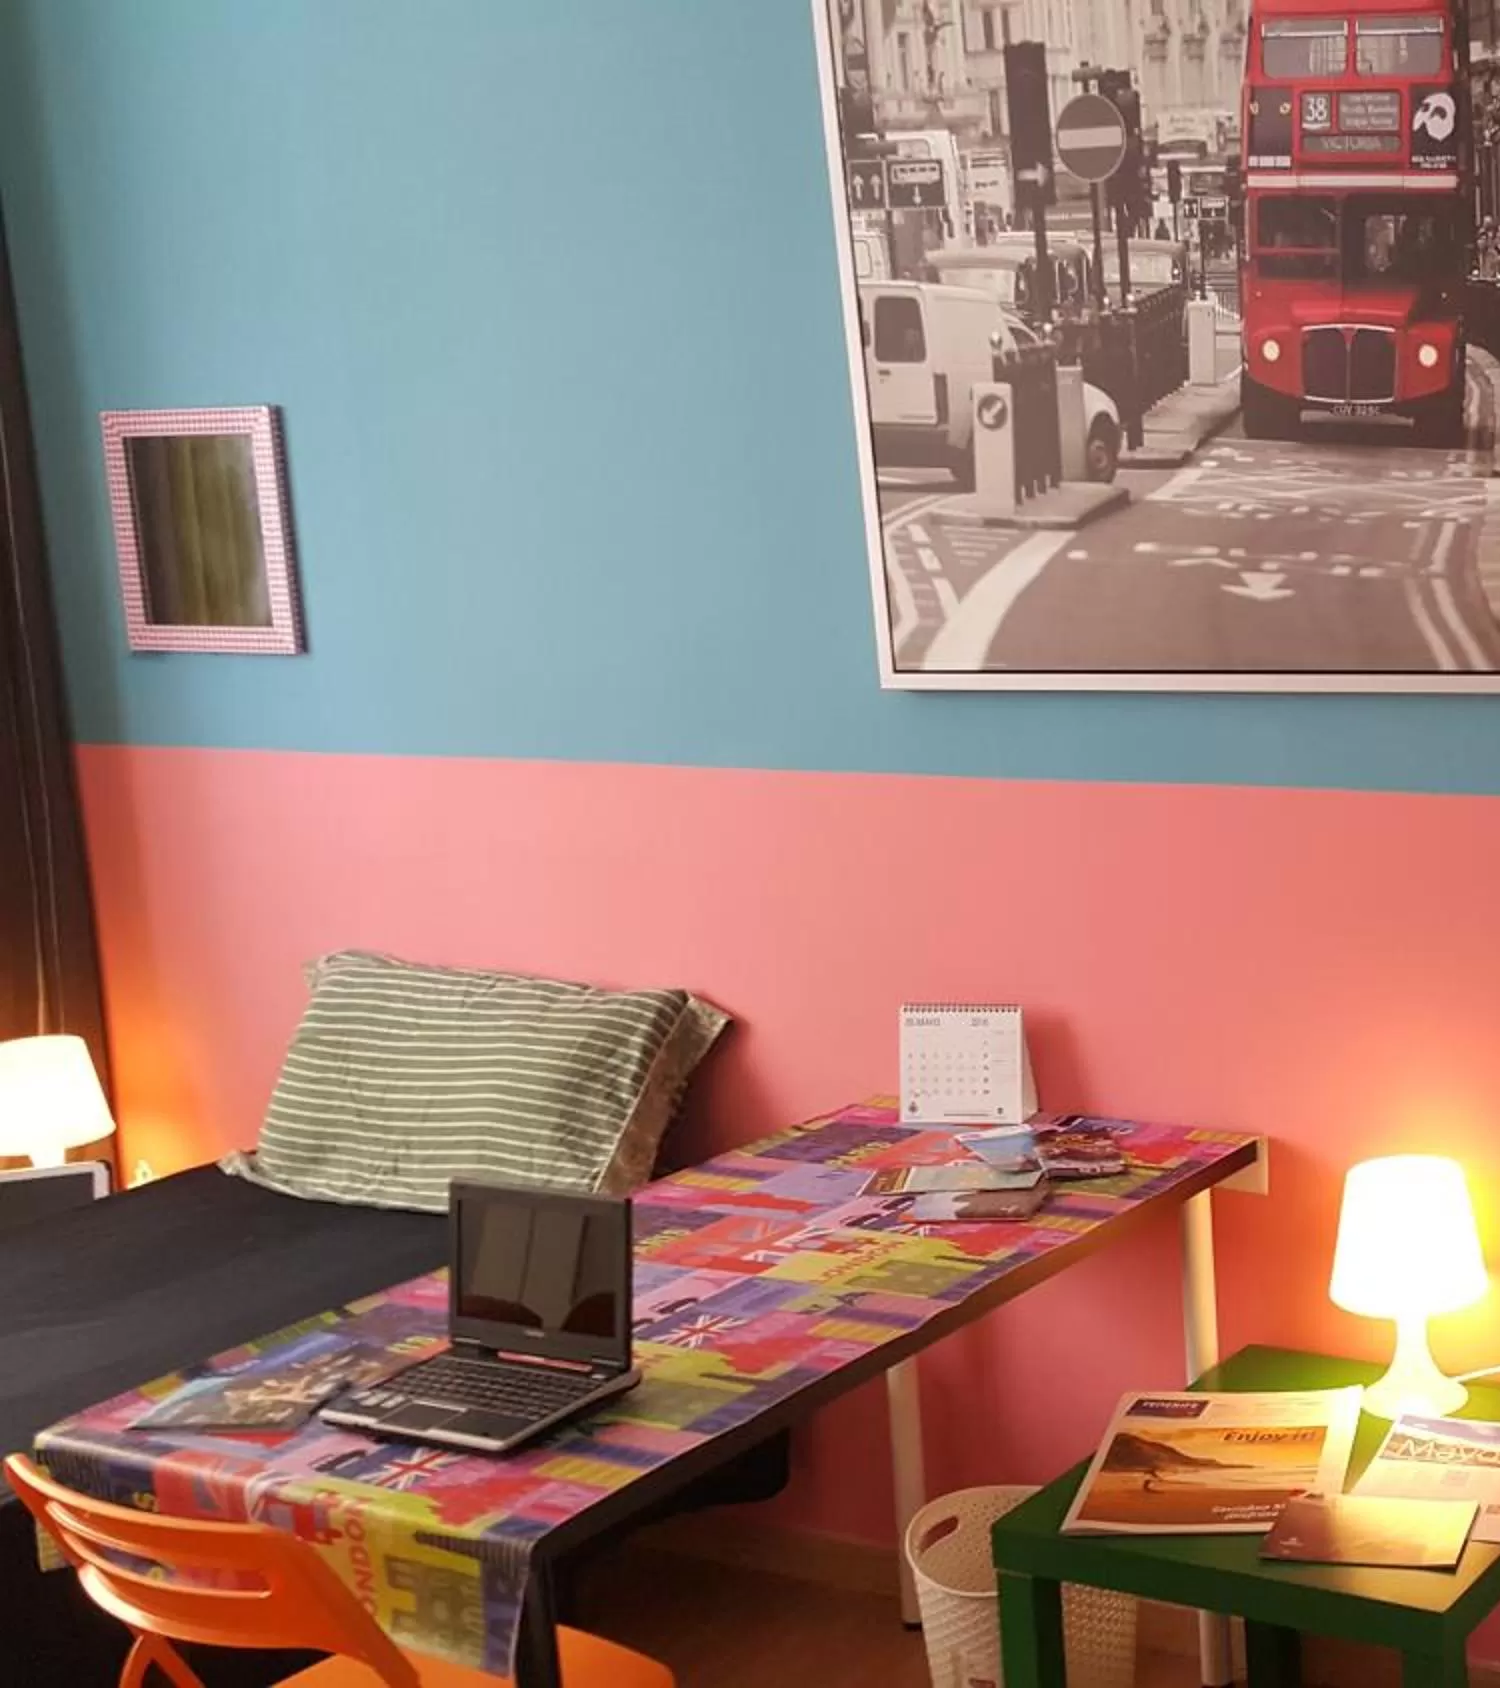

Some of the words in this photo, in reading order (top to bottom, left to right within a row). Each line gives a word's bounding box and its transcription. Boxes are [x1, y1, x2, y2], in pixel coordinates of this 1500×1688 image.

[1305, 97, 1328, 122] 38
[1320, 136, 1382, 151] VICTORIA
[1222, 1429, 1288, 1445] Enjoy
